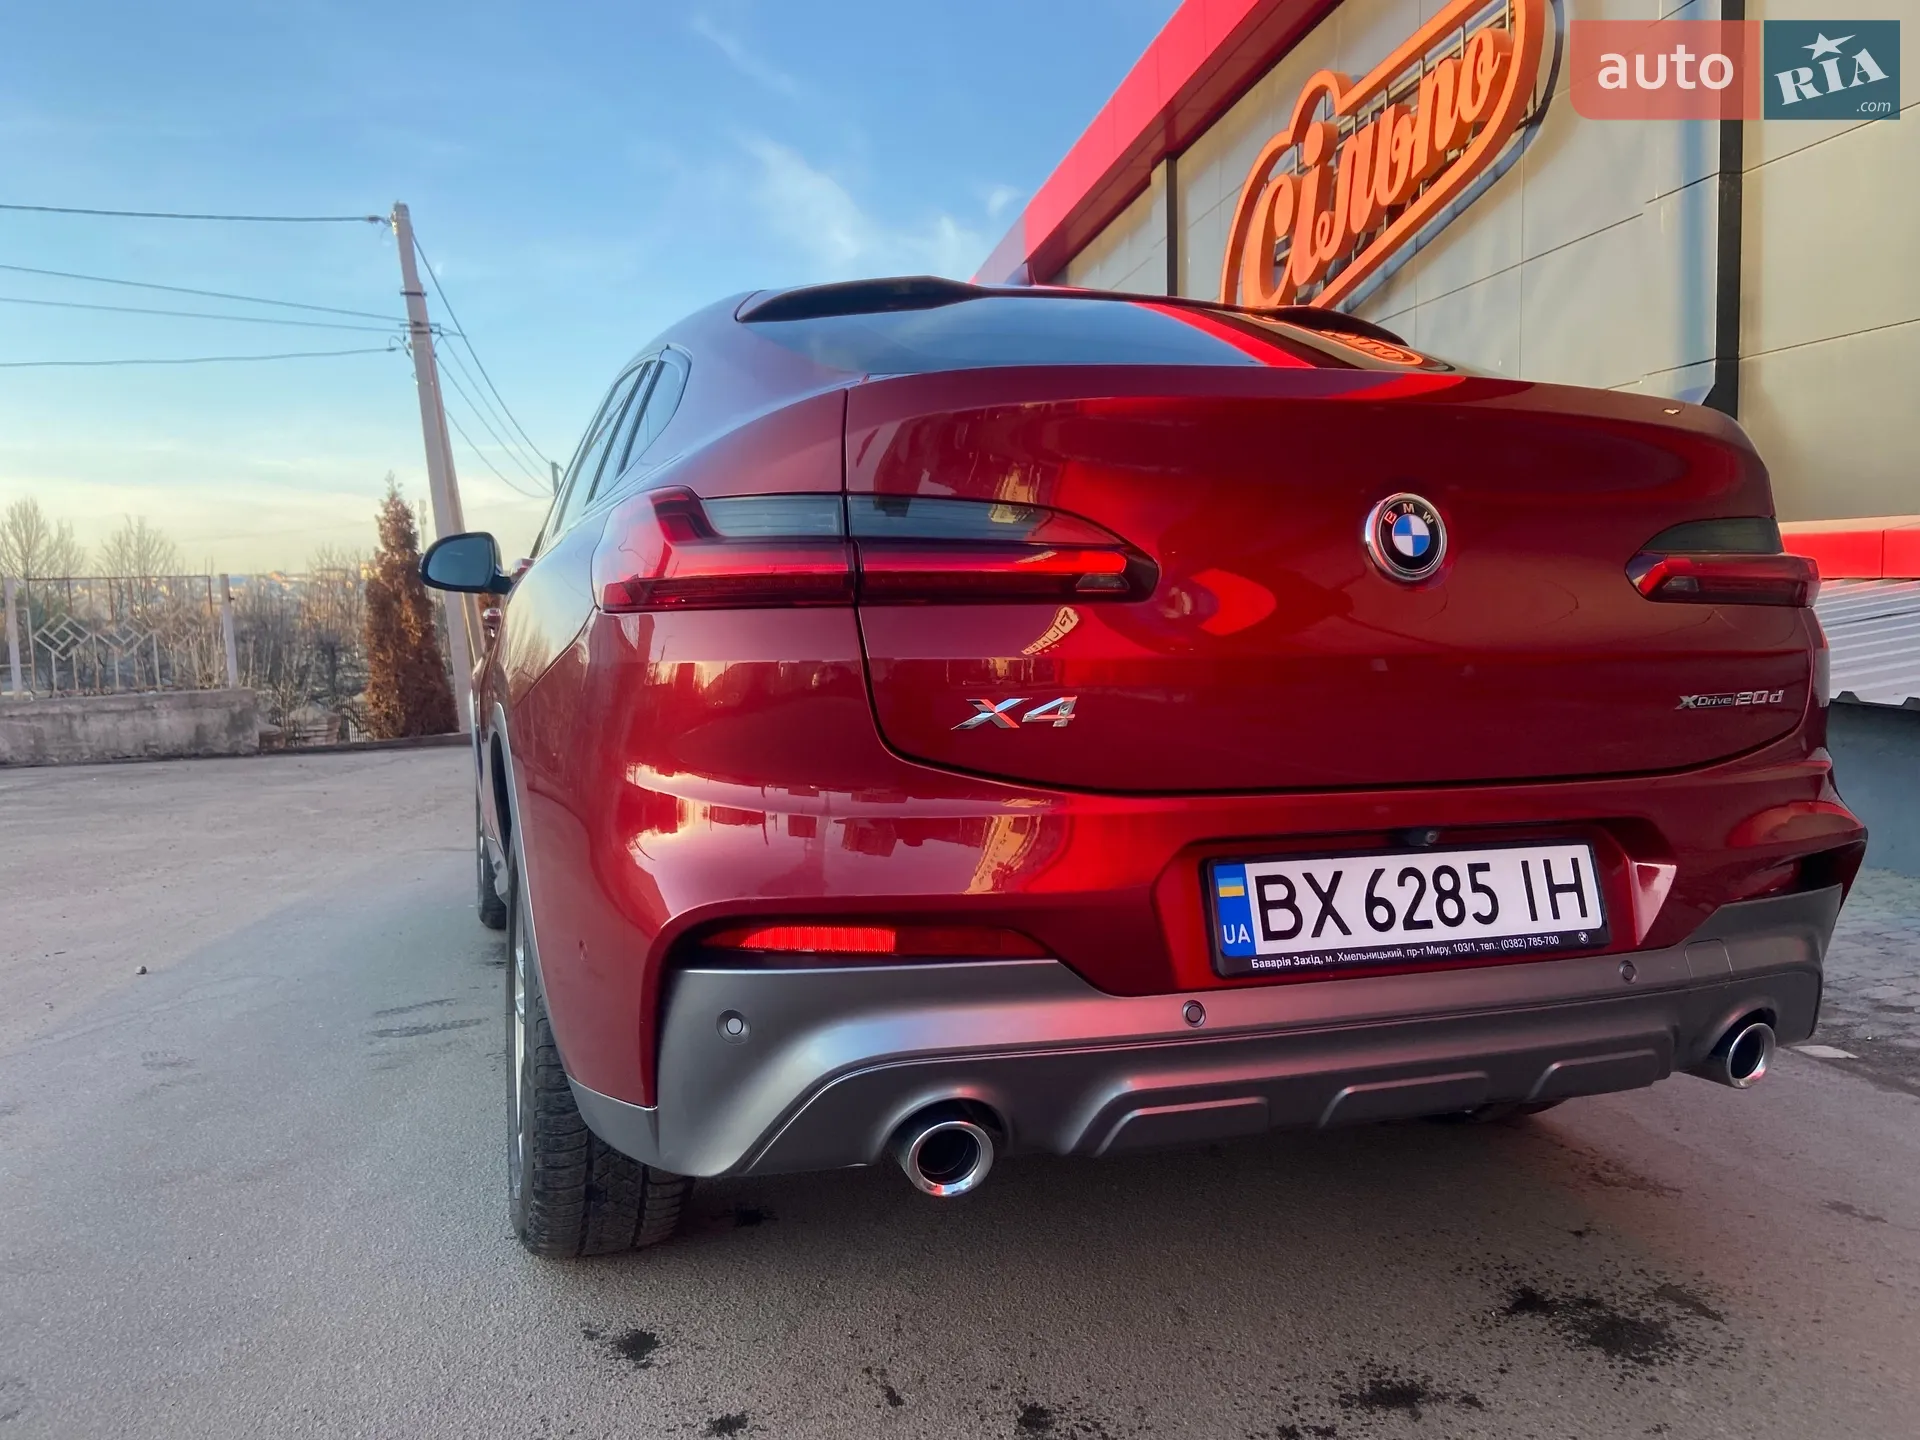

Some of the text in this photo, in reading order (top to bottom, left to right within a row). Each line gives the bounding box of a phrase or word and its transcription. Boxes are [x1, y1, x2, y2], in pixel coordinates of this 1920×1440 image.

[1242, 28, 1512, 308] Сільпо
[1384, 503, 1434, 525] BMW
[1255, 857, 1588, 943] BX 6285 IH
[1223, 924, 1251, 945] UA
[1251, 956, 1292, 969] Баварія
[1293, 954, 1324, 966] Захід,
[1325, 955, 1336, 963] м.
[1337, 948, 1405, 962] Хмельницький,
[1426, 945, 1452, 956] Миру,
[1501, 937, 1527, 950] (0382)
[1528, 935, 1560, 947] 785-700
